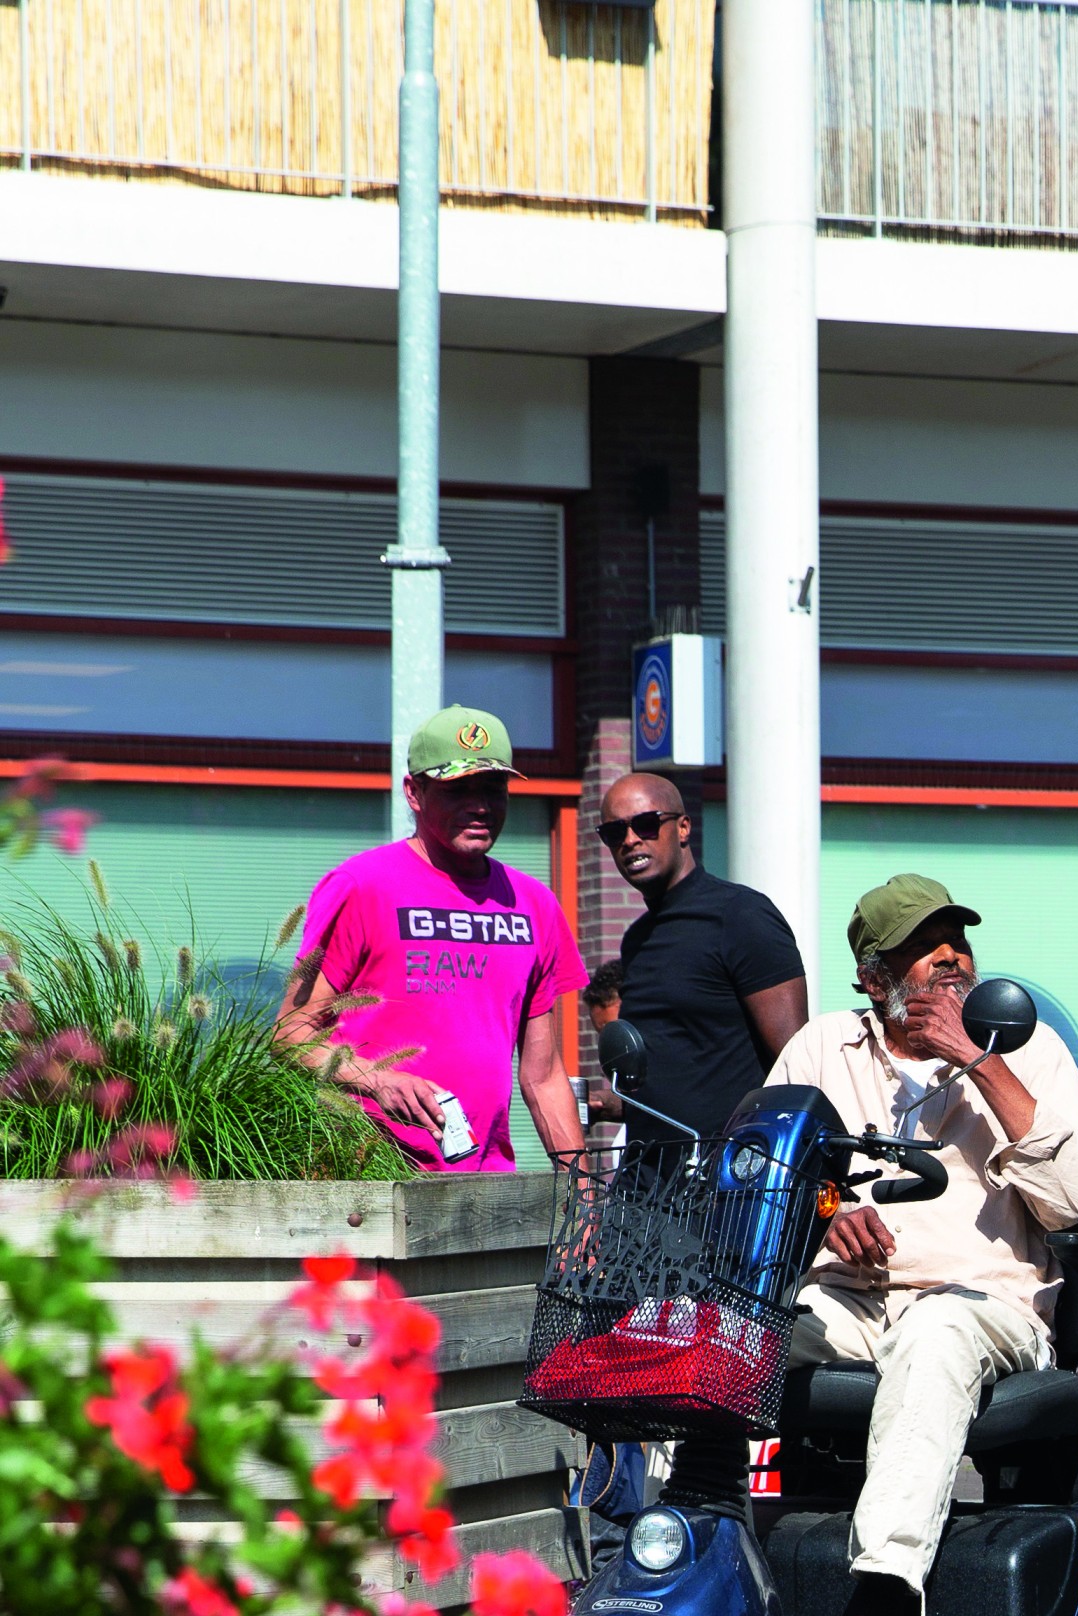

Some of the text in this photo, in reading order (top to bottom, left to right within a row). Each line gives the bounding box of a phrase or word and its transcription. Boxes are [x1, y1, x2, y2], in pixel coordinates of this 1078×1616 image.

[408, 909, 531, 942] G-STAR
[406, 950, 489, 979] RAW
[406, 979, 457, 995] DNM
[538, 1256, 708, 1302] FRIENDS
[605, 1600, 657, 1610] STERLING
